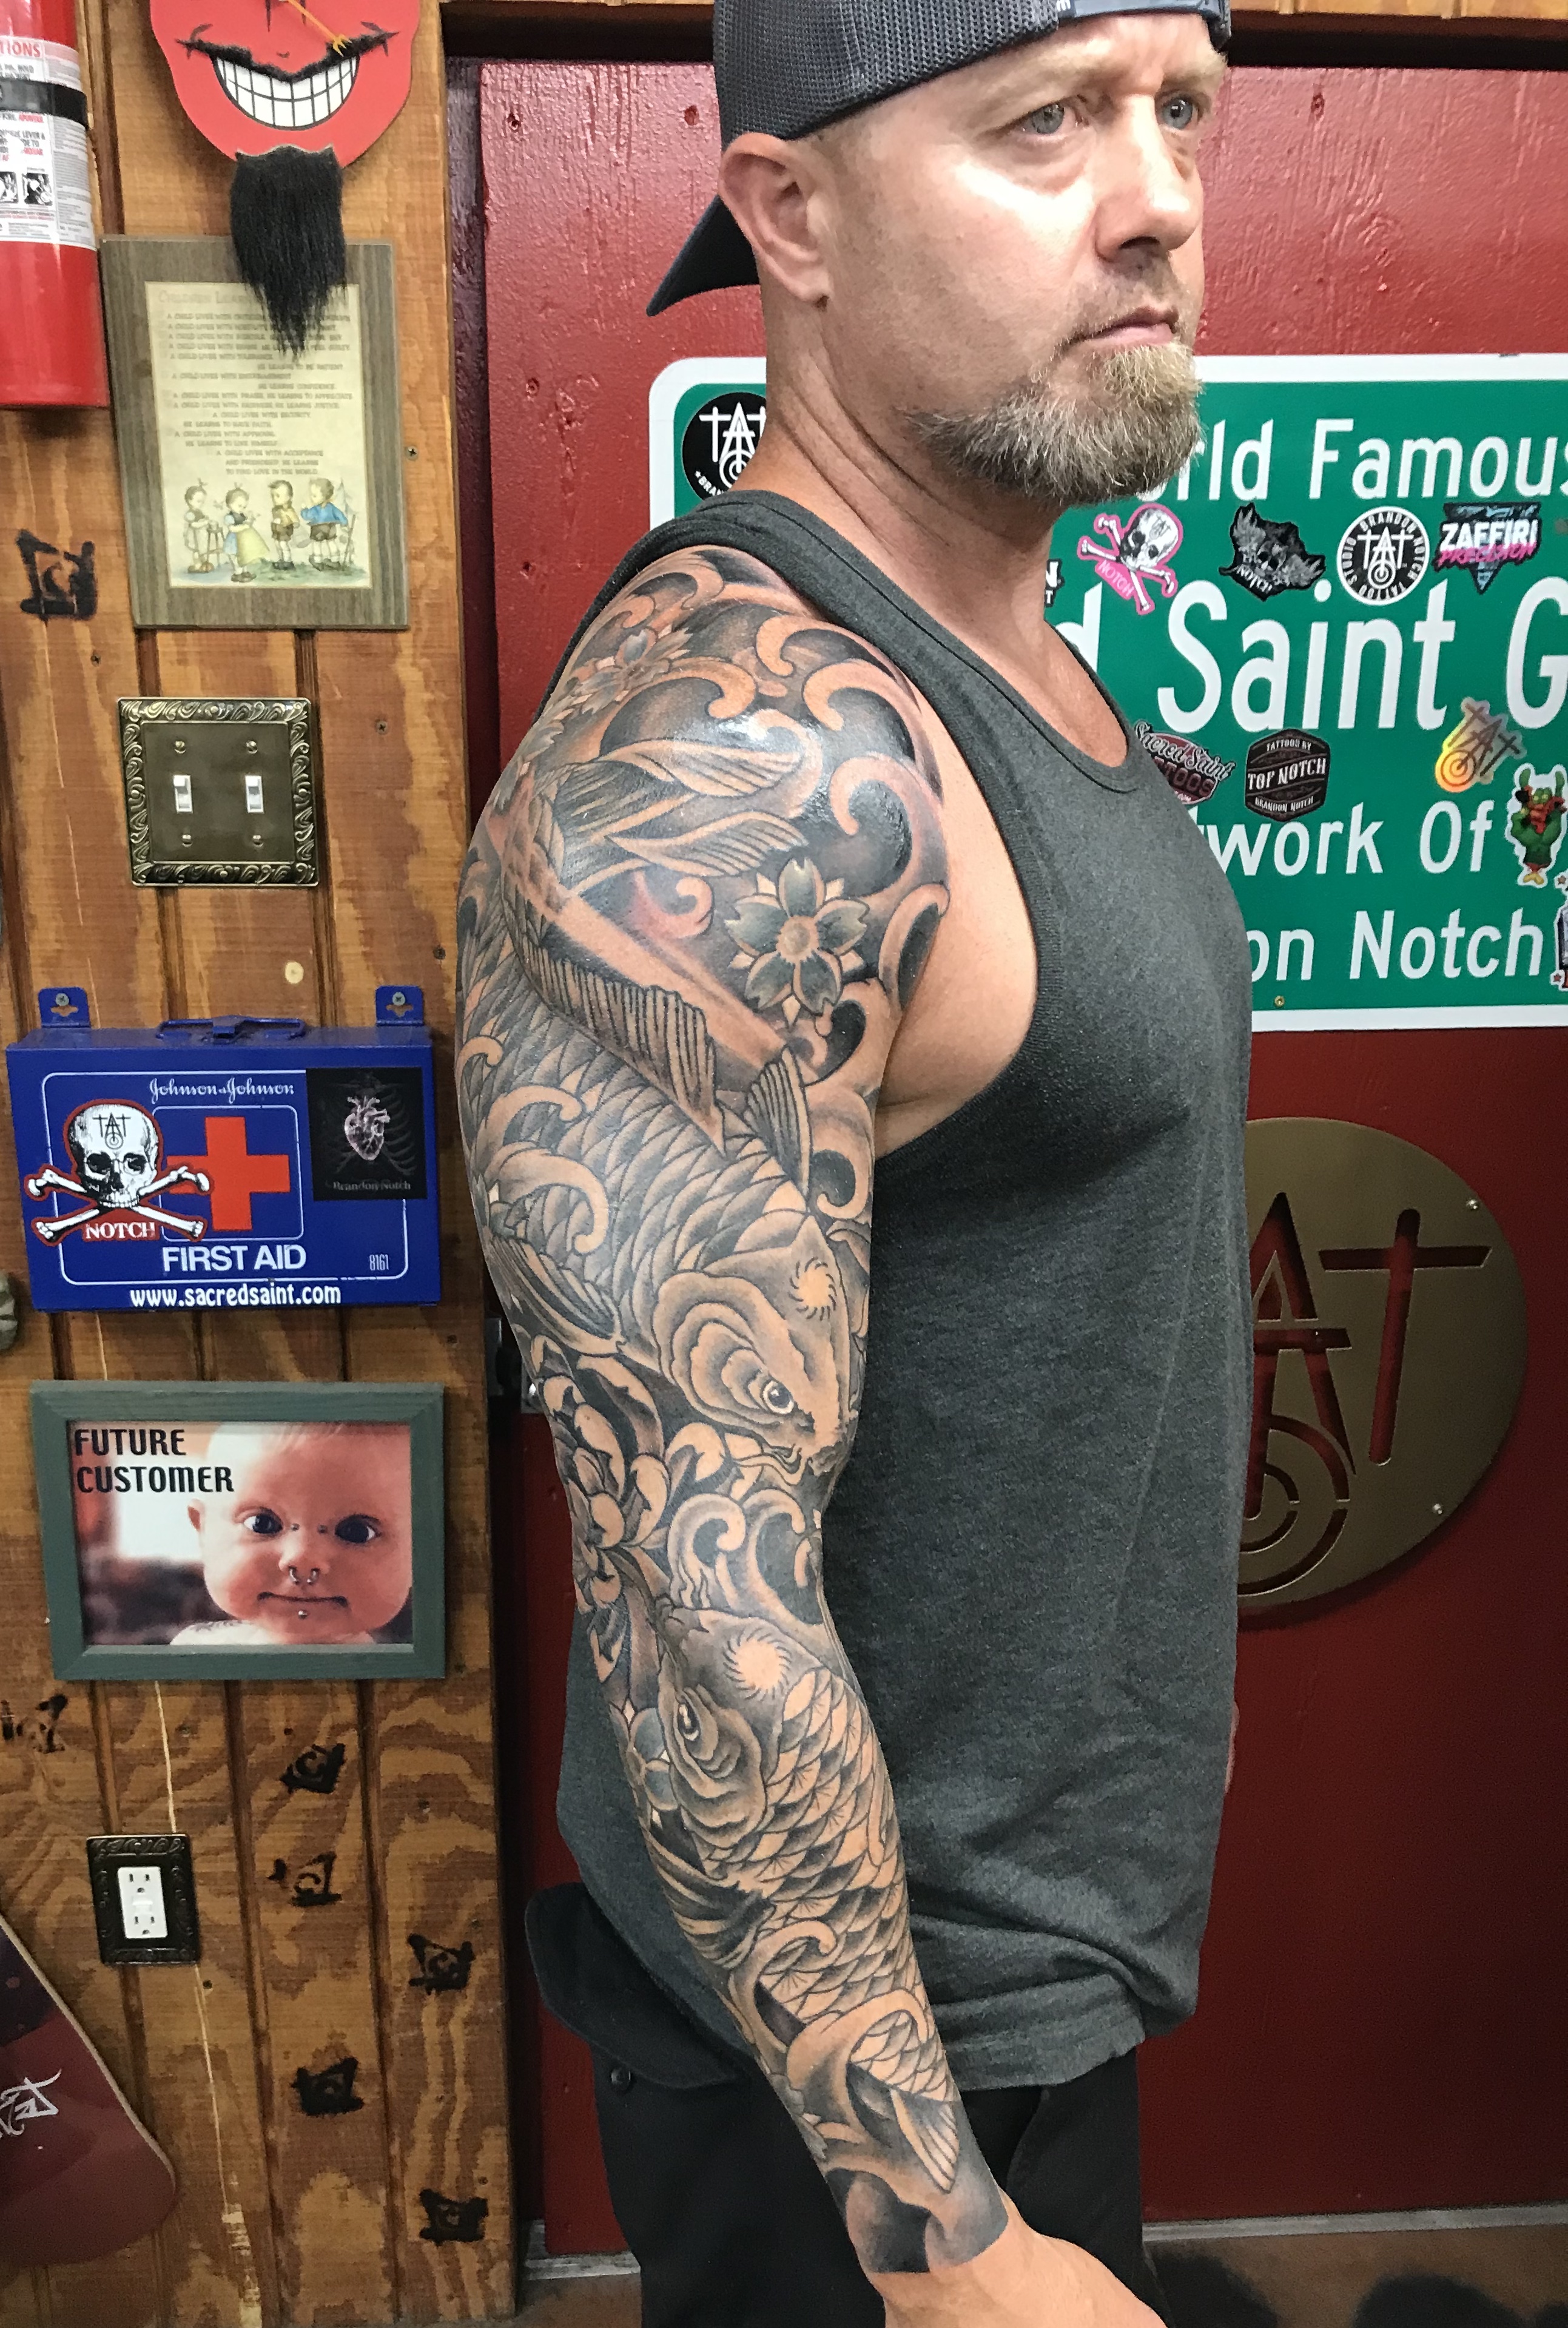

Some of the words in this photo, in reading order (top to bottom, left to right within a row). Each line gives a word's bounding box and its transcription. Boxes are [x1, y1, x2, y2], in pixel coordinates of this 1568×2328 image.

[1137, 419, 1273, 502] rld
[1309, 417, 1568, 500] Famou
[1439, 519, 1539, 552] ZAFFIRI
[1097, 559, 1135, 597] NOTCH
[1157, 577, 1456, 733] Saint
[1267, 738, 1300, 752] TATTOOS
[1248, 770, 1275, 790] TOP
[1277, 758, 1327, 785] NOTCH
[1191, 802, 1384, 877] work
[1419, 799, 1495, 874] Of
[1350, 906, 1544, 980] Notch
[149, 1078, 217, 1104] Johnson
[226, 1077, 294, 1104] Johnson
[86, 1221, 155, 1239] NOTCH
[163, 1245, 248, 1272] FIRST
[254, 1244, 306, 1270] AID
[369, 1253, 389, 1271] 8161
[130, 1283, 341, 1307] www.sacredsaint.com
[75, 1428, 187, 1456] FUTURE
[76, 1465, 235, 1493] CUSTOMER
